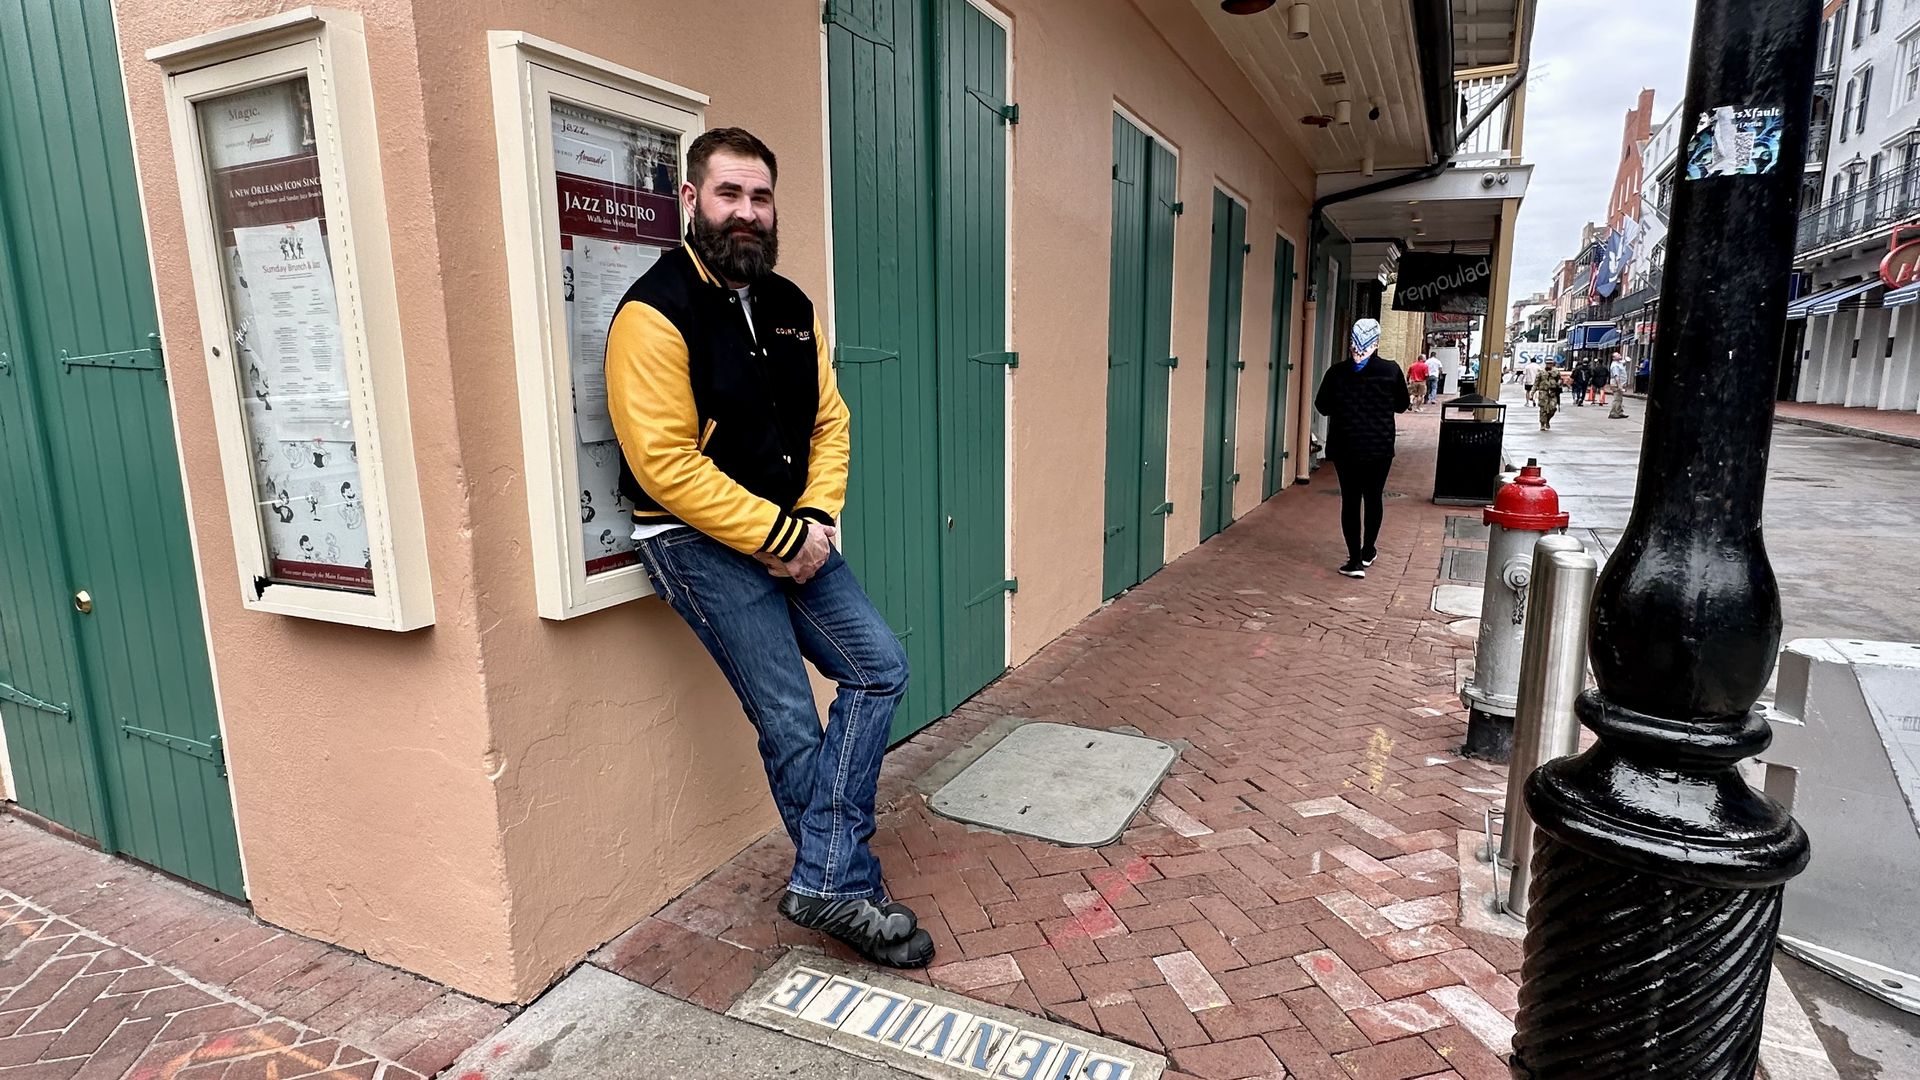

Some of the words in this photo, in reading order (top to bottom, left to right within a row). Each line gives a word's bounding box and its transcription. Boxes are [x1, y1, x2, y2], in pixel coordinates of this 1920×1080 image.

[228, 107, 260, 121] Magic.
[561, 118, 589, 136] Jazz.
[235, 187, 250, 197] NEW
[251, 184, 283, 196] ORLEANS
[284, 180, 302, 191] ICON
[564, 191, 600, 213] JAZZ
[605, 198, 656, 222] BISTRO
[587, 214, 612, 226] Walk-ins
[262, 264, 288, 274] Sunday
[1398, 257, 1492, 307] remoulad
